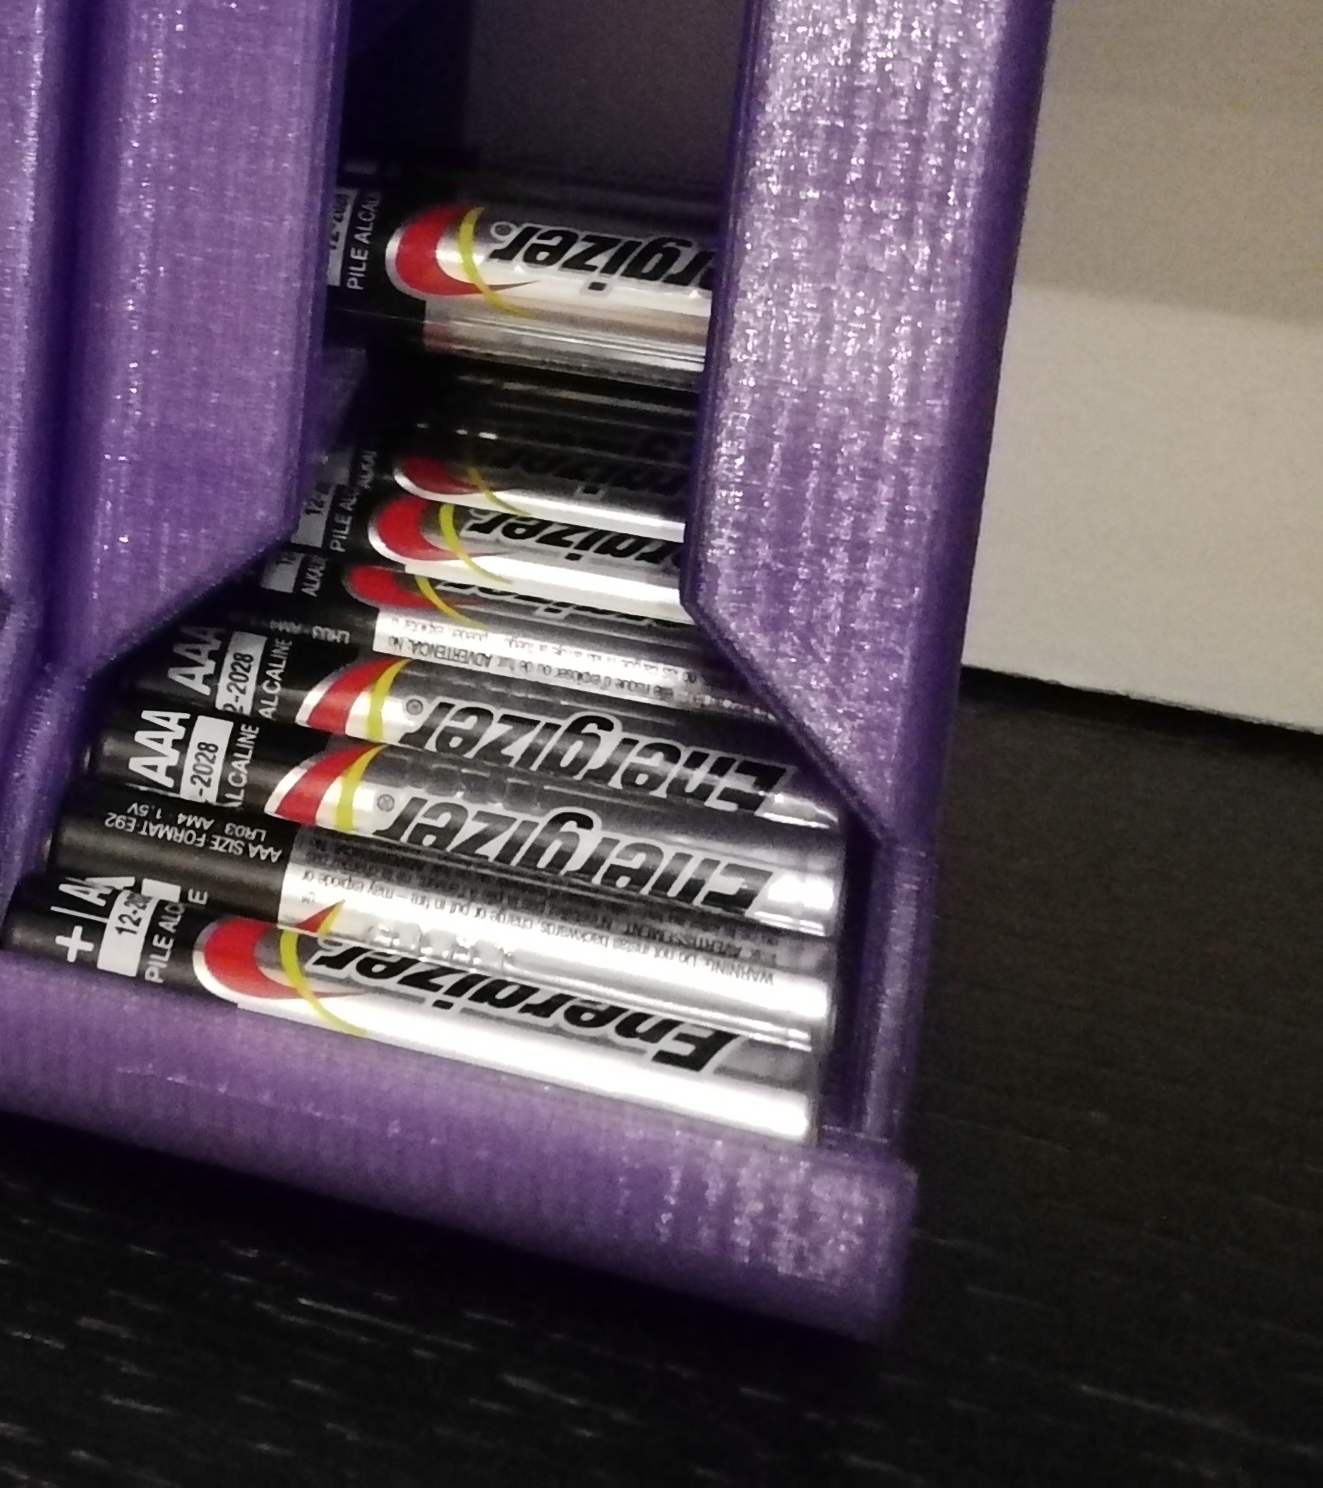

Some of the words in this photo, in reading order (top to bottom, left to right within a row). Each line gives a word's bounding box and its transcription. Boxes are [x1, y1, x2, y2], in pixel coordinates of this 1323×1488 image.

[258, 637, 293, 720] ALCALINE
[128, 710, 192, 789] AAA
[127, 802, 163, 820] 1.5V
[177, 813, 215, 830] AM4
[224, 823, 267, 842] LR03
[247, 843, 283, 863] AAA
[375, 793, 774, 913] Energizer
[145, 934, 174, 983] PILE
